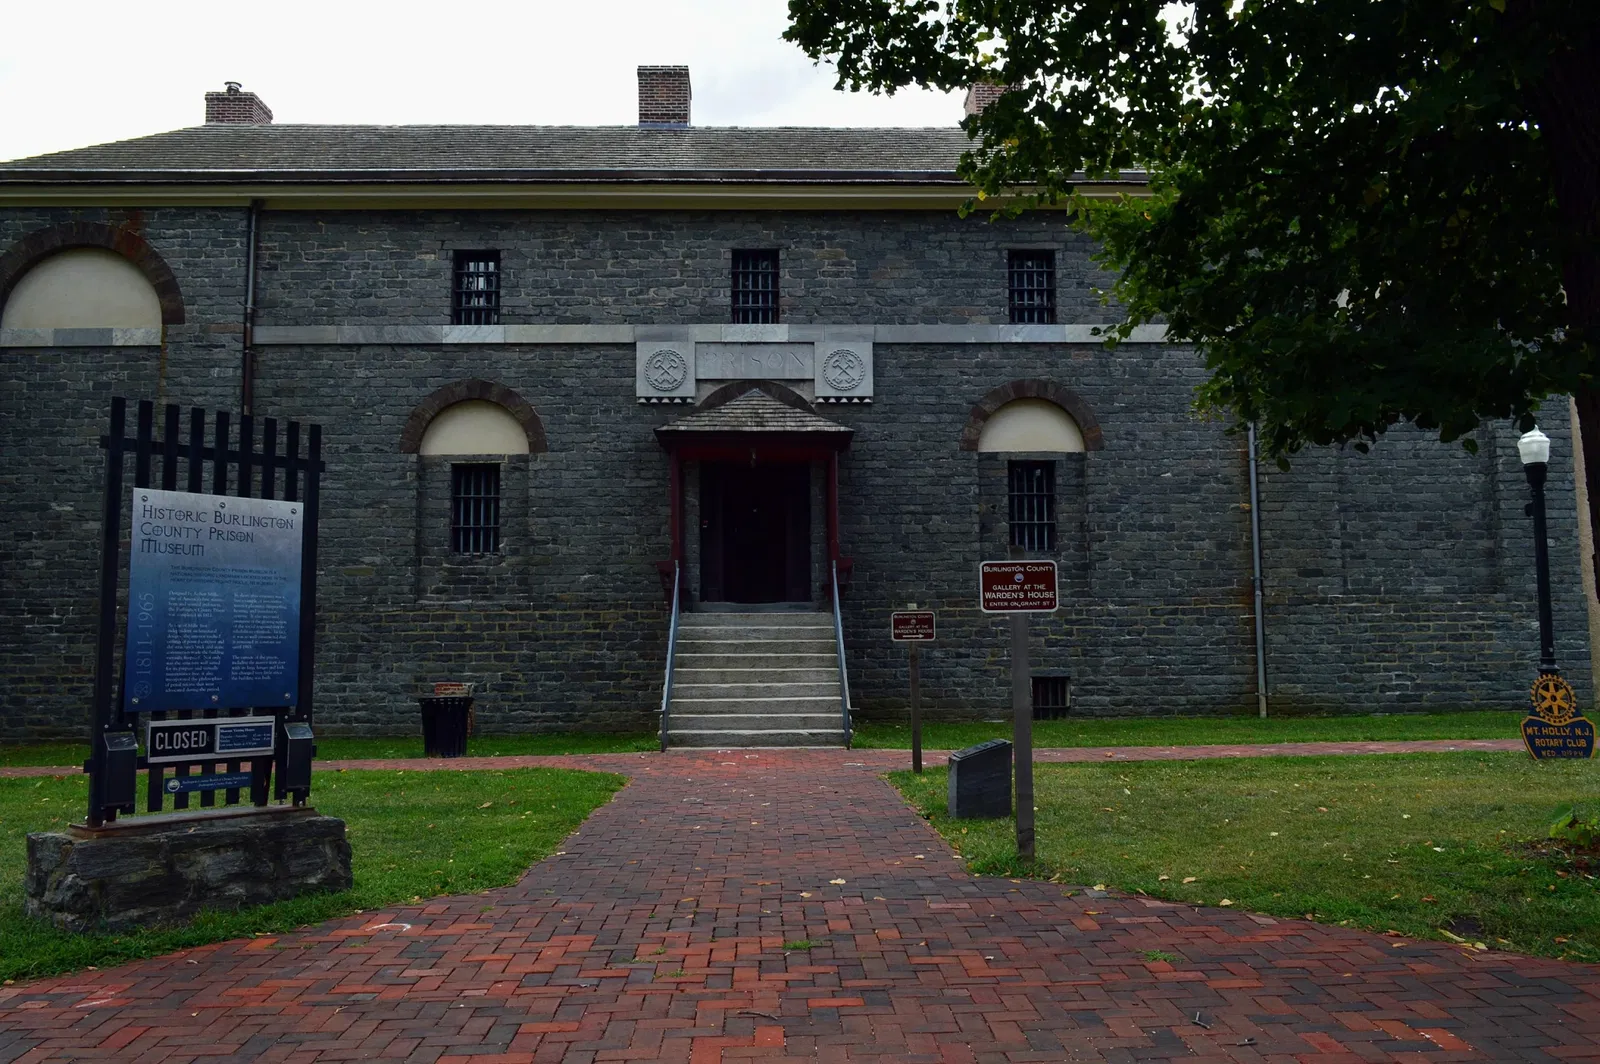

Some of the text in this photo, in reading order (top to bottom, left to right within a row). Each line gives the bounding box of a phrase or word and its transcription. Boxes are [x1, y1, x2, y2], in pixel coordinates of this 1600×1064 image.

[704, 352, 810, 368] PRISON
[136, 592, 154, 676] 1811-1965
[1526, 727, 1540, 735] MT.
[156, 730, 207, 750] CLOSED
[1566, 739, 1587, 747] CLUB
